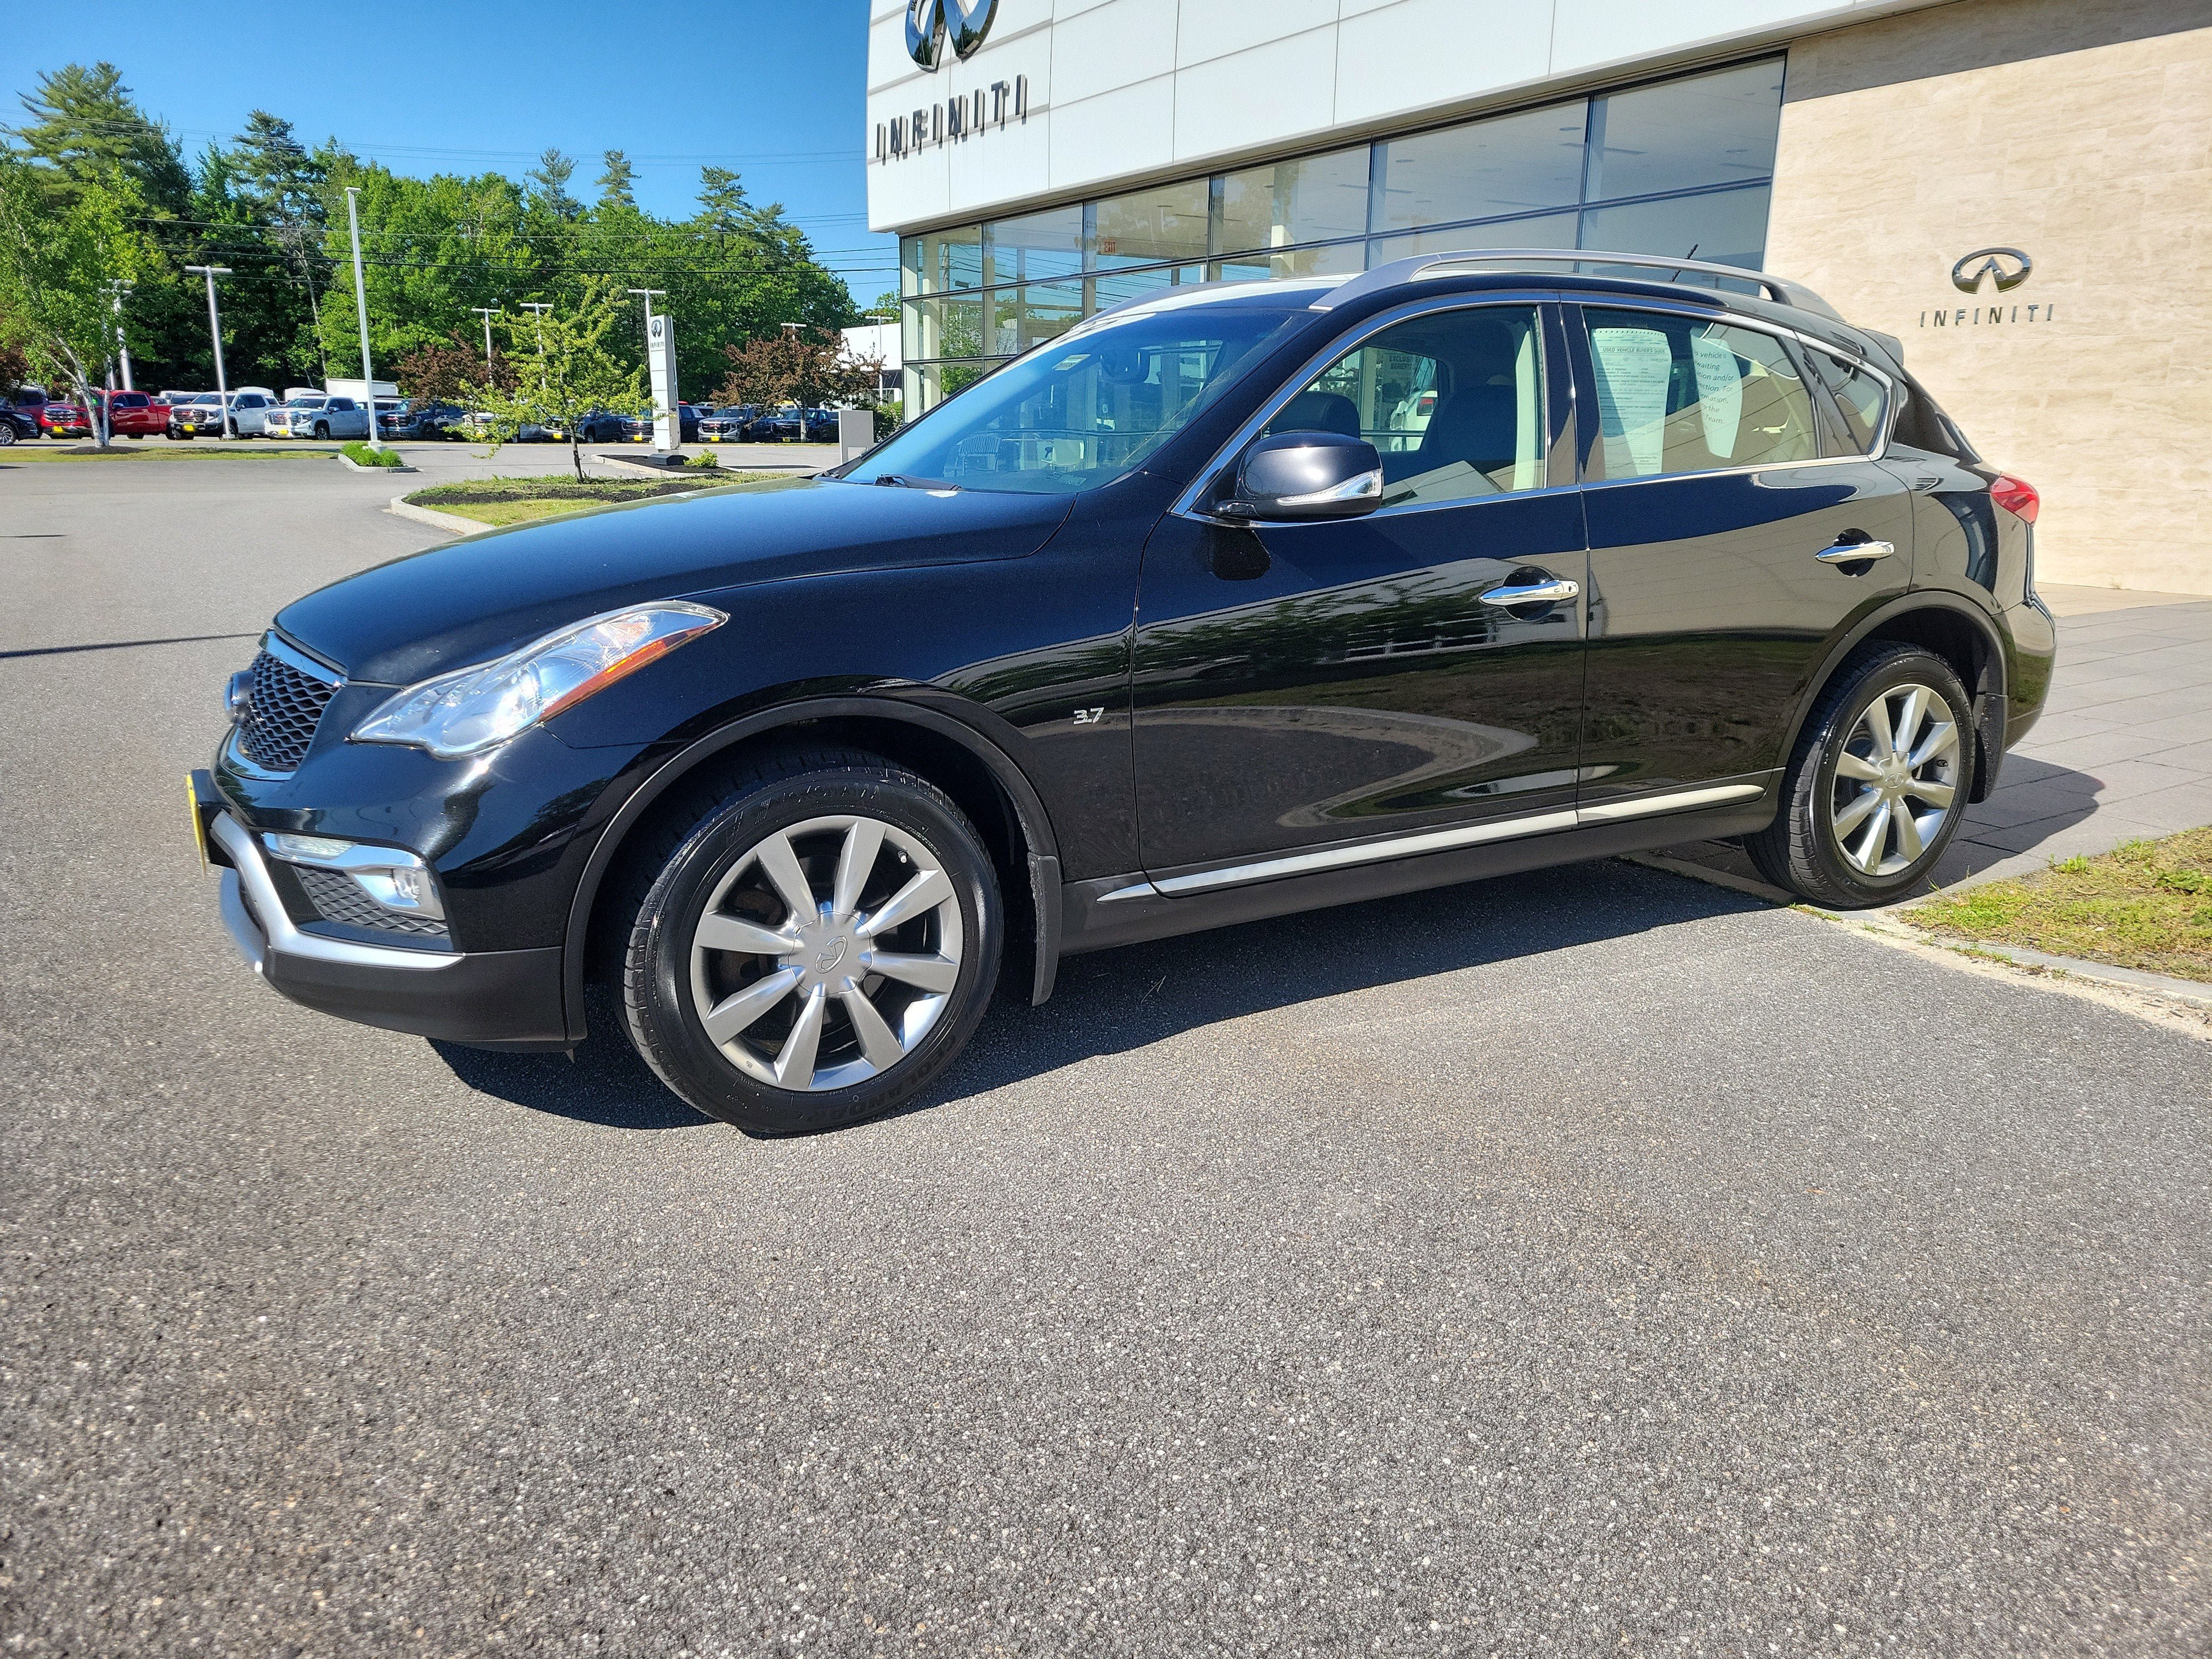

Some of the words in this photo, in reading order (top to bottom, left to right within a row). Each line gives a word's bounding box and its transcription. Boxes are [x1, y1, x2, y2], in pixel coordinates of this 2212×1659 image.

[876, 74, 1028, 160] INFINITI
[1104, 241, 1116, 252] EXIT
[1920, 303, 2054, 328] INFINITI
[1073, 707, 1104, 725] 3.7
